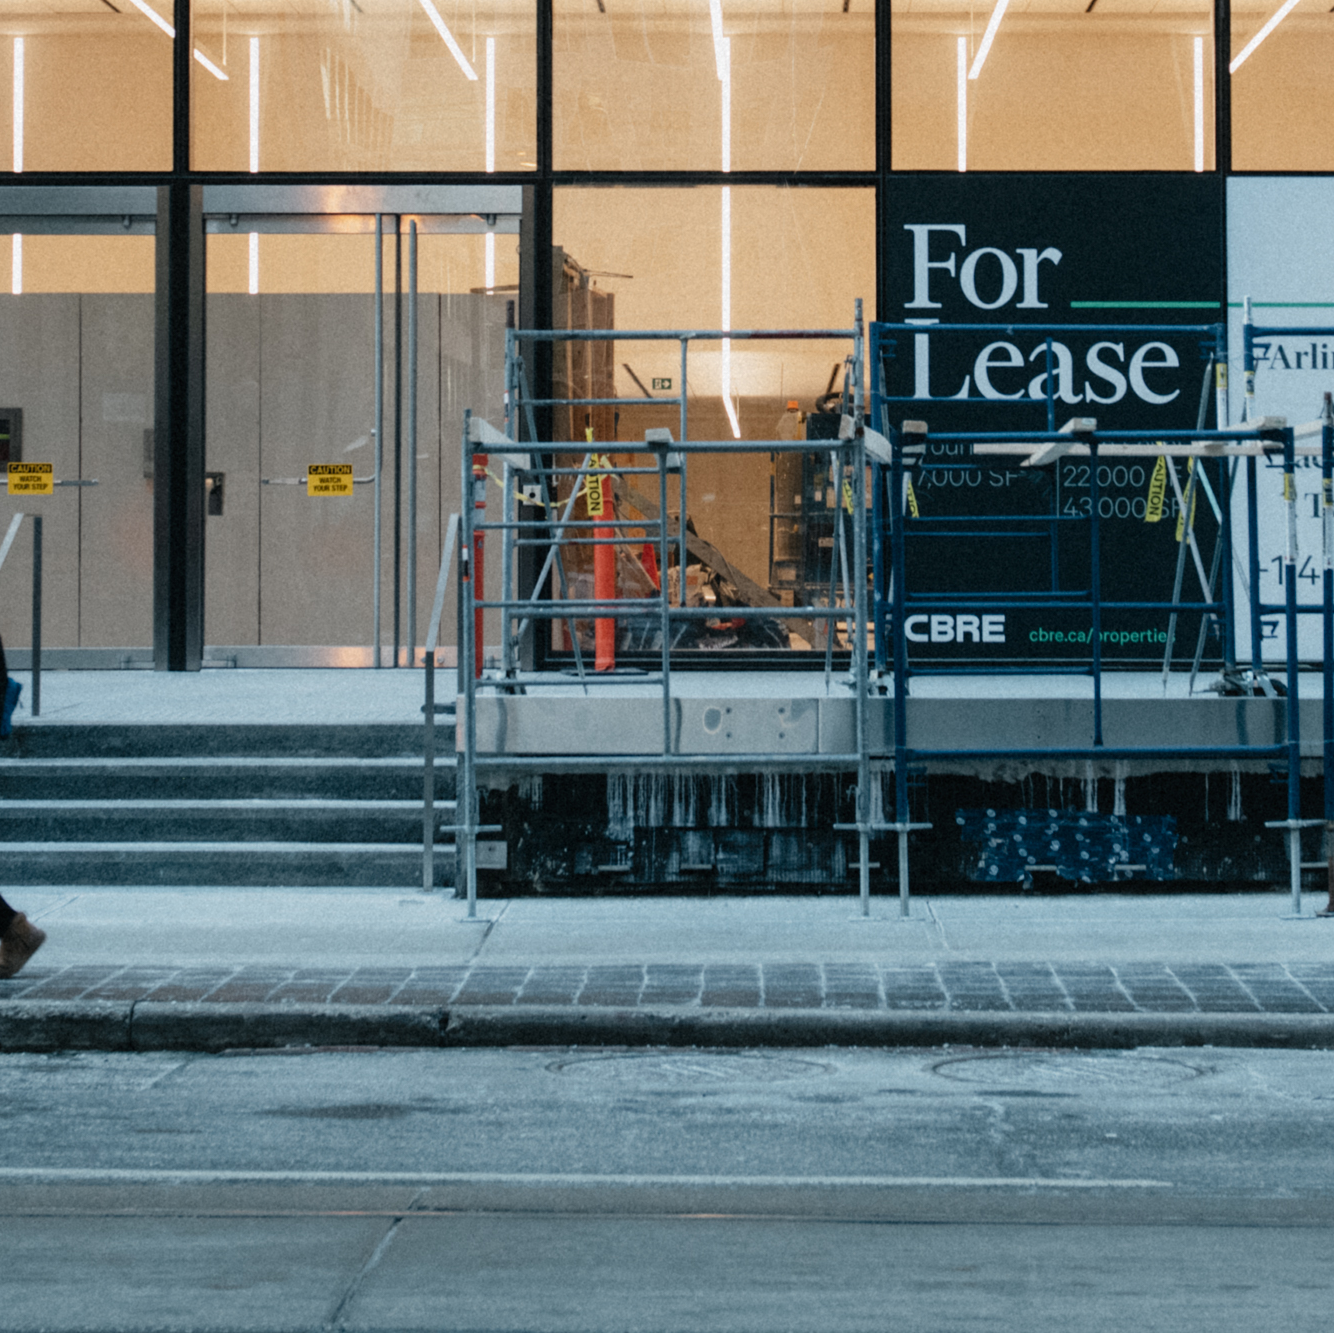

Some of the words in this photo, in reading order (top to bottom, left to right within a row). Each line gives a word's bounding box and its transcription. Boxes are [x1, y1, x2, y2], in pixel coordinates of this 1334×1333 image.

[903, 223, 1063, 310] For
[903, 317, 1180, 405] Lease
[10, 464, 51, 473] CAUTION
[310, 465, 351, 474] CAUTION
[904, 614, 1006, 643] CBRE
